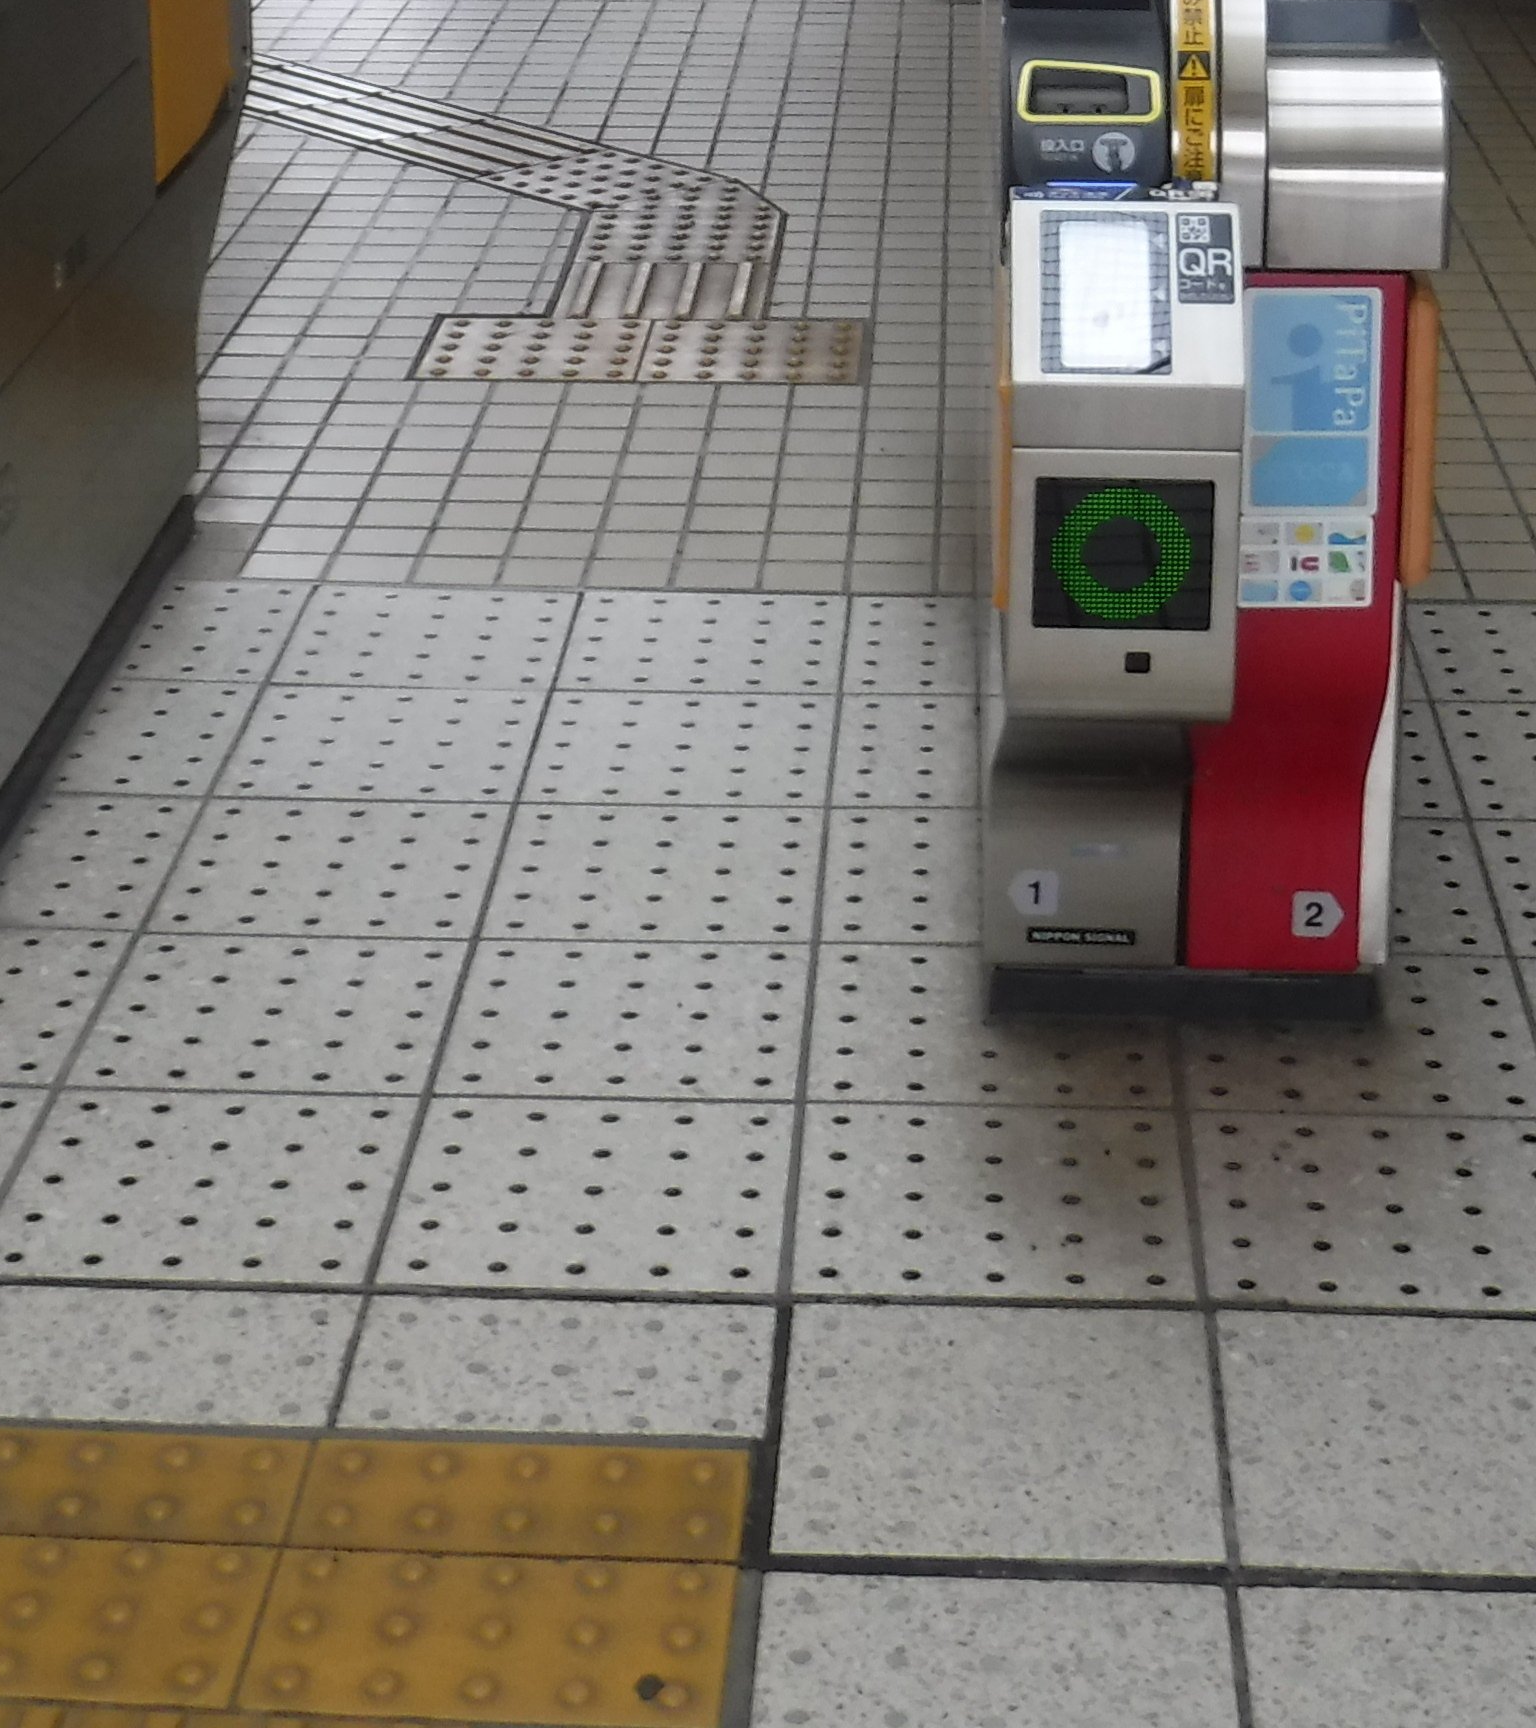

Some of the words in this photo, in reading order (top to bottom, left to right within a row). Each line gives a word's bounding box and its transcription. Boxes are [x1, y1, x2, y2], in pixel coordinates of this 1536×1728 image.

[1179, 247, 1233, 277] QR
[1331, 303, 1368, 426] PiTaPa
[1289, 555, 1321, 572] IC
[1027, 880, 1041, 905] 1
[1303, 901, 1325, 928] 2
